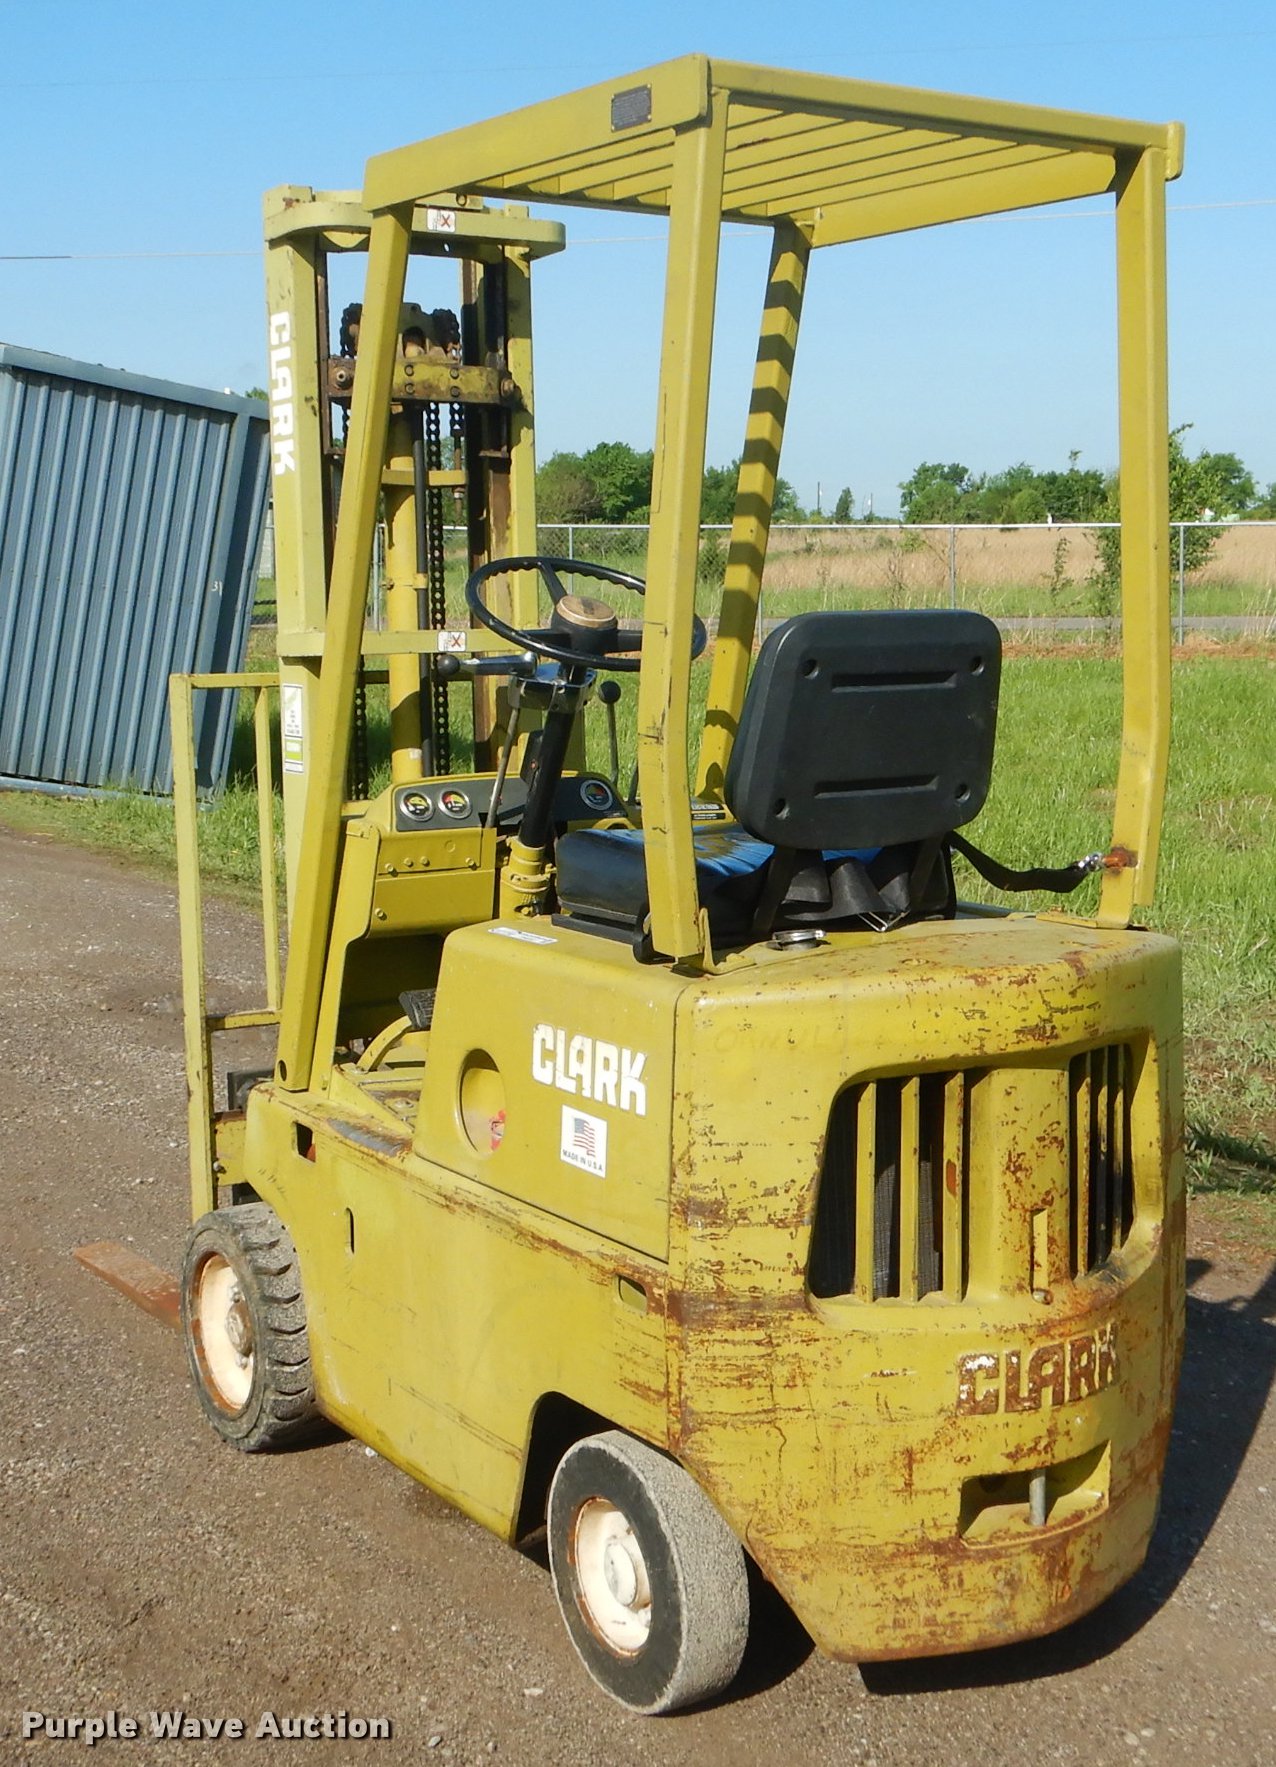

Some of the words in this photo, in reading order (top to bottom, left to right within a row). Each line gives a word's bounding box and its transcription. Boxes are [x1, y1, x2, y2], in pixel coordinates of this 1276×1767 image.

[270, 311, 295, 475] CLARK
[533, 1023, 647, 1117] CLARK
[562, 1149, 578, 1161] MADE
[957, 1321, 1121, 1416] CLARK
